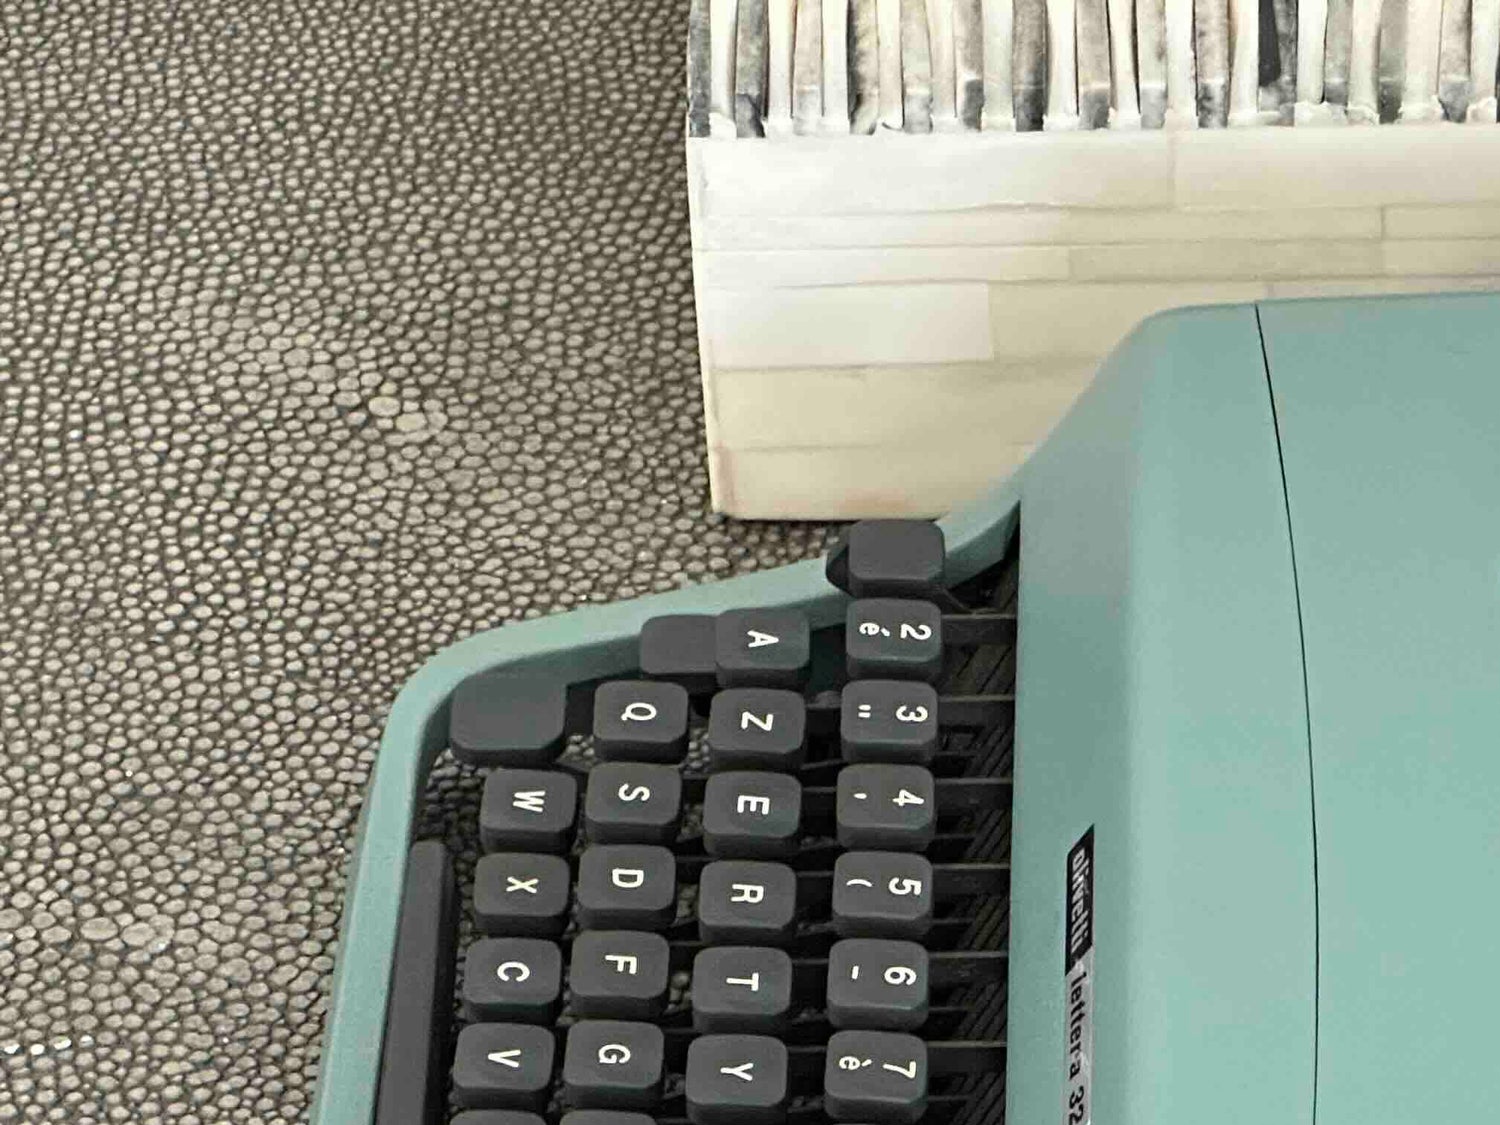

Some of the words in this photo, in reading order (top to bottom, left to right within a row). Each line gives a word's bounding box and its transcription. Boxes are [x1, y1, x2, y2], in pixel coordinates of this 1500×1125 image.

[746, 629, 780, 648] A
[857, 620, 892, 638] é
[900, 623, 932, 641] 2
[620, 702, 658, 722] Q
[740, 711, 774, 732] Z
[895, 705, 929, 723] 3
[512, 790, 546, 813] W
[617, 783, 651, 802] S
[892, 789, 925, 807] 4
[736, 794, 771, 816] E
[505, 876, 539, 894] X
[611, 867, 645, 889] D
[845, 878, 873, 888] (
[888, 877, 922, 896] 5
[730, 883, 765, 904] R
[1070, 846, 1090, 957] olivetti
[496, 961, 531, 983] C
[604, 954, 638, 975] F
[725, 972, 760, 992] T
[883, 966, 917, 986] 6
[1068, 972, 1089, 1080] lettera
[487, 1049, 522, 1068] V
[598, 1043, 632, 1064] G
[719, 1062, 754, 1082] Y
[838, 1055, 873, 1073] è
[882, 1060, 917, 1079] 7
